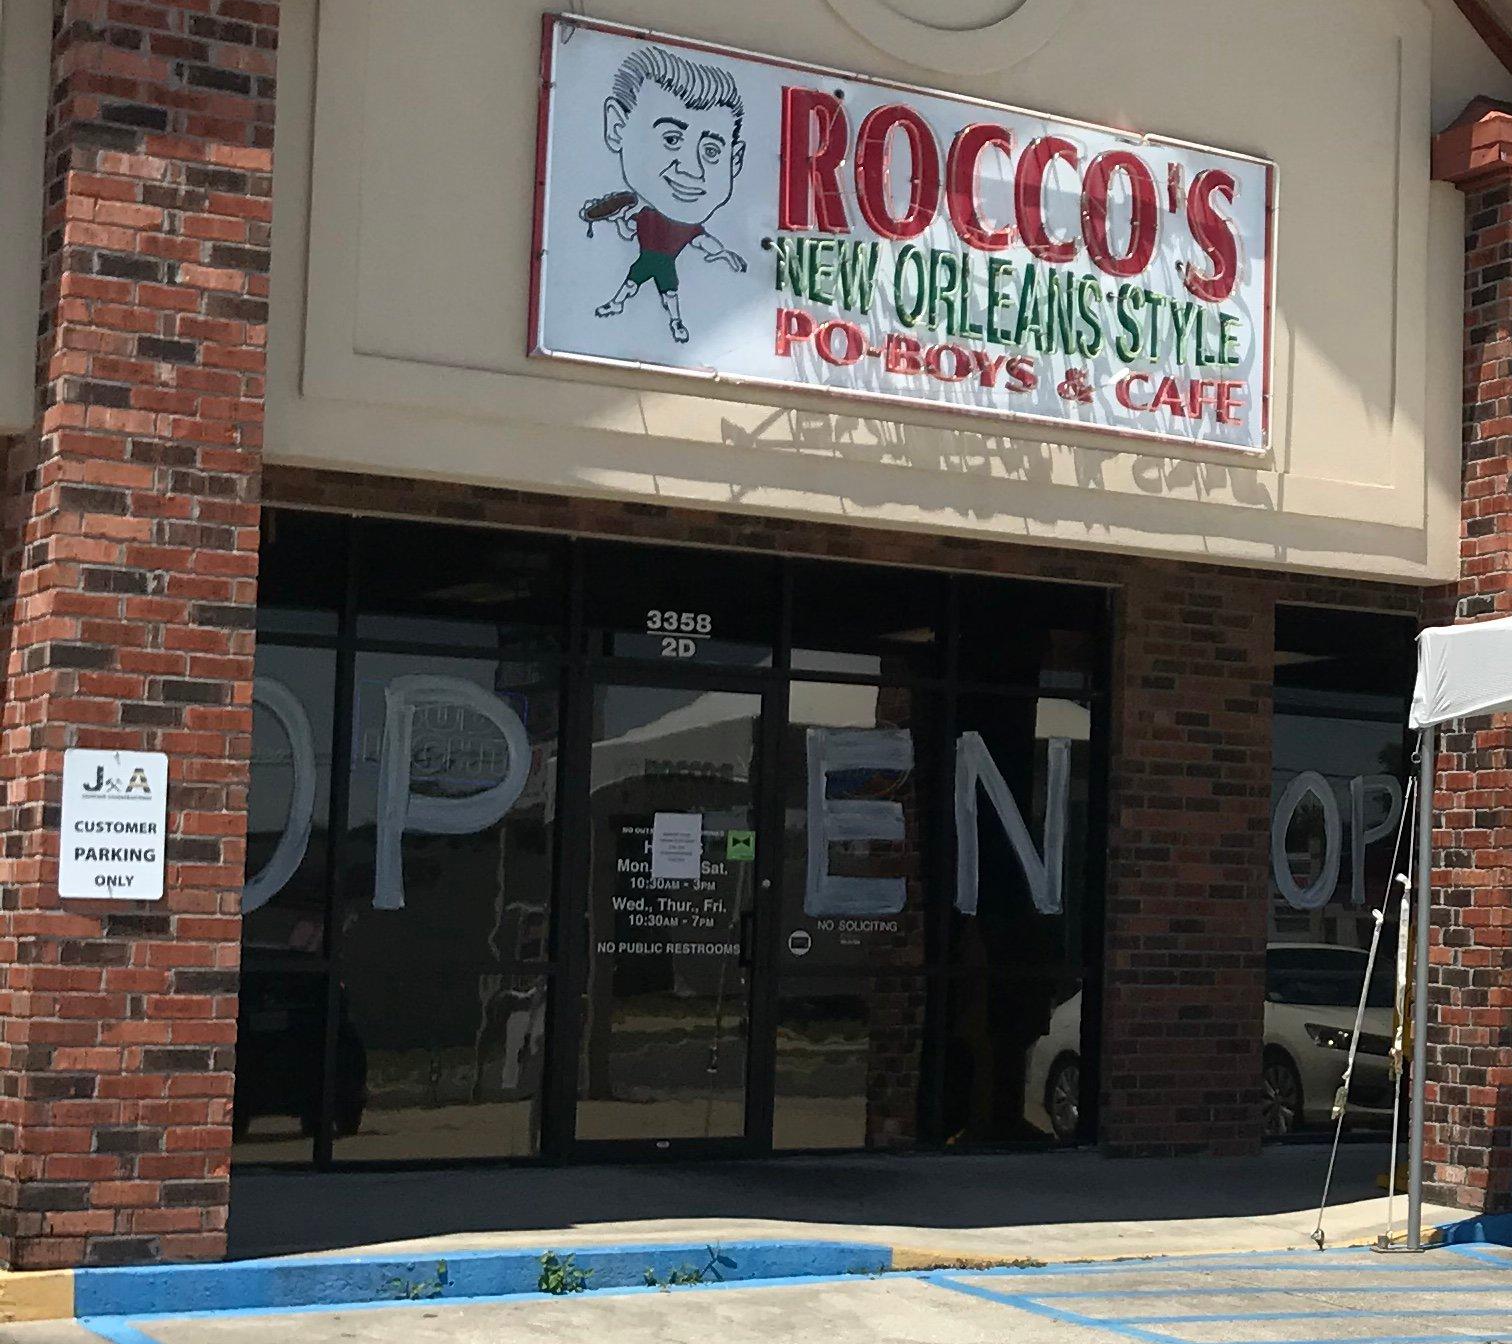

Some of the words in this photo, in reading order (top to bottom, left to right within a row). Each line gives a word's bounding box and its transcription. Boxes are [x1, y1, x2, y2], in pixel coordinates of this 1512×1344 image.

[779, 84, 1241, 303] ROCCO'S
[774, 234, 884, 317] NEW
[892, 241, 1105, 361] ORLEANS
[1113, 282, 1241, 368] STYLE
[773, 308, 1039, 393] PO-BOYS
[1056, 367, 1095, 405] &
[1116, 371, 1247, 427] CAFE
[646, 609, 712, 633] 3358
[661, 636, 696, 658] 2D
[74, 820, 157, 835] CUSTOMER
[74, 847, 156, 862] PARKING
[701, 860, 728, 875] Sat.
[94, 875, 134, 887] ONLY
[612, 896, 653, 913] Wed.,
[704, 898, 727, 913] Fri.
[628, 914, 679, 927] 10:30AM
[692, 915, 715, 928] 7PM
[818, 920, 835, 931] NO
[838, 920, 897, 932] SOLICITING
[597, 942, 616, 954] NO
[618, 942, 664, 954] PUBLIC
[665, 943, 741, 955] RESTROOMS
